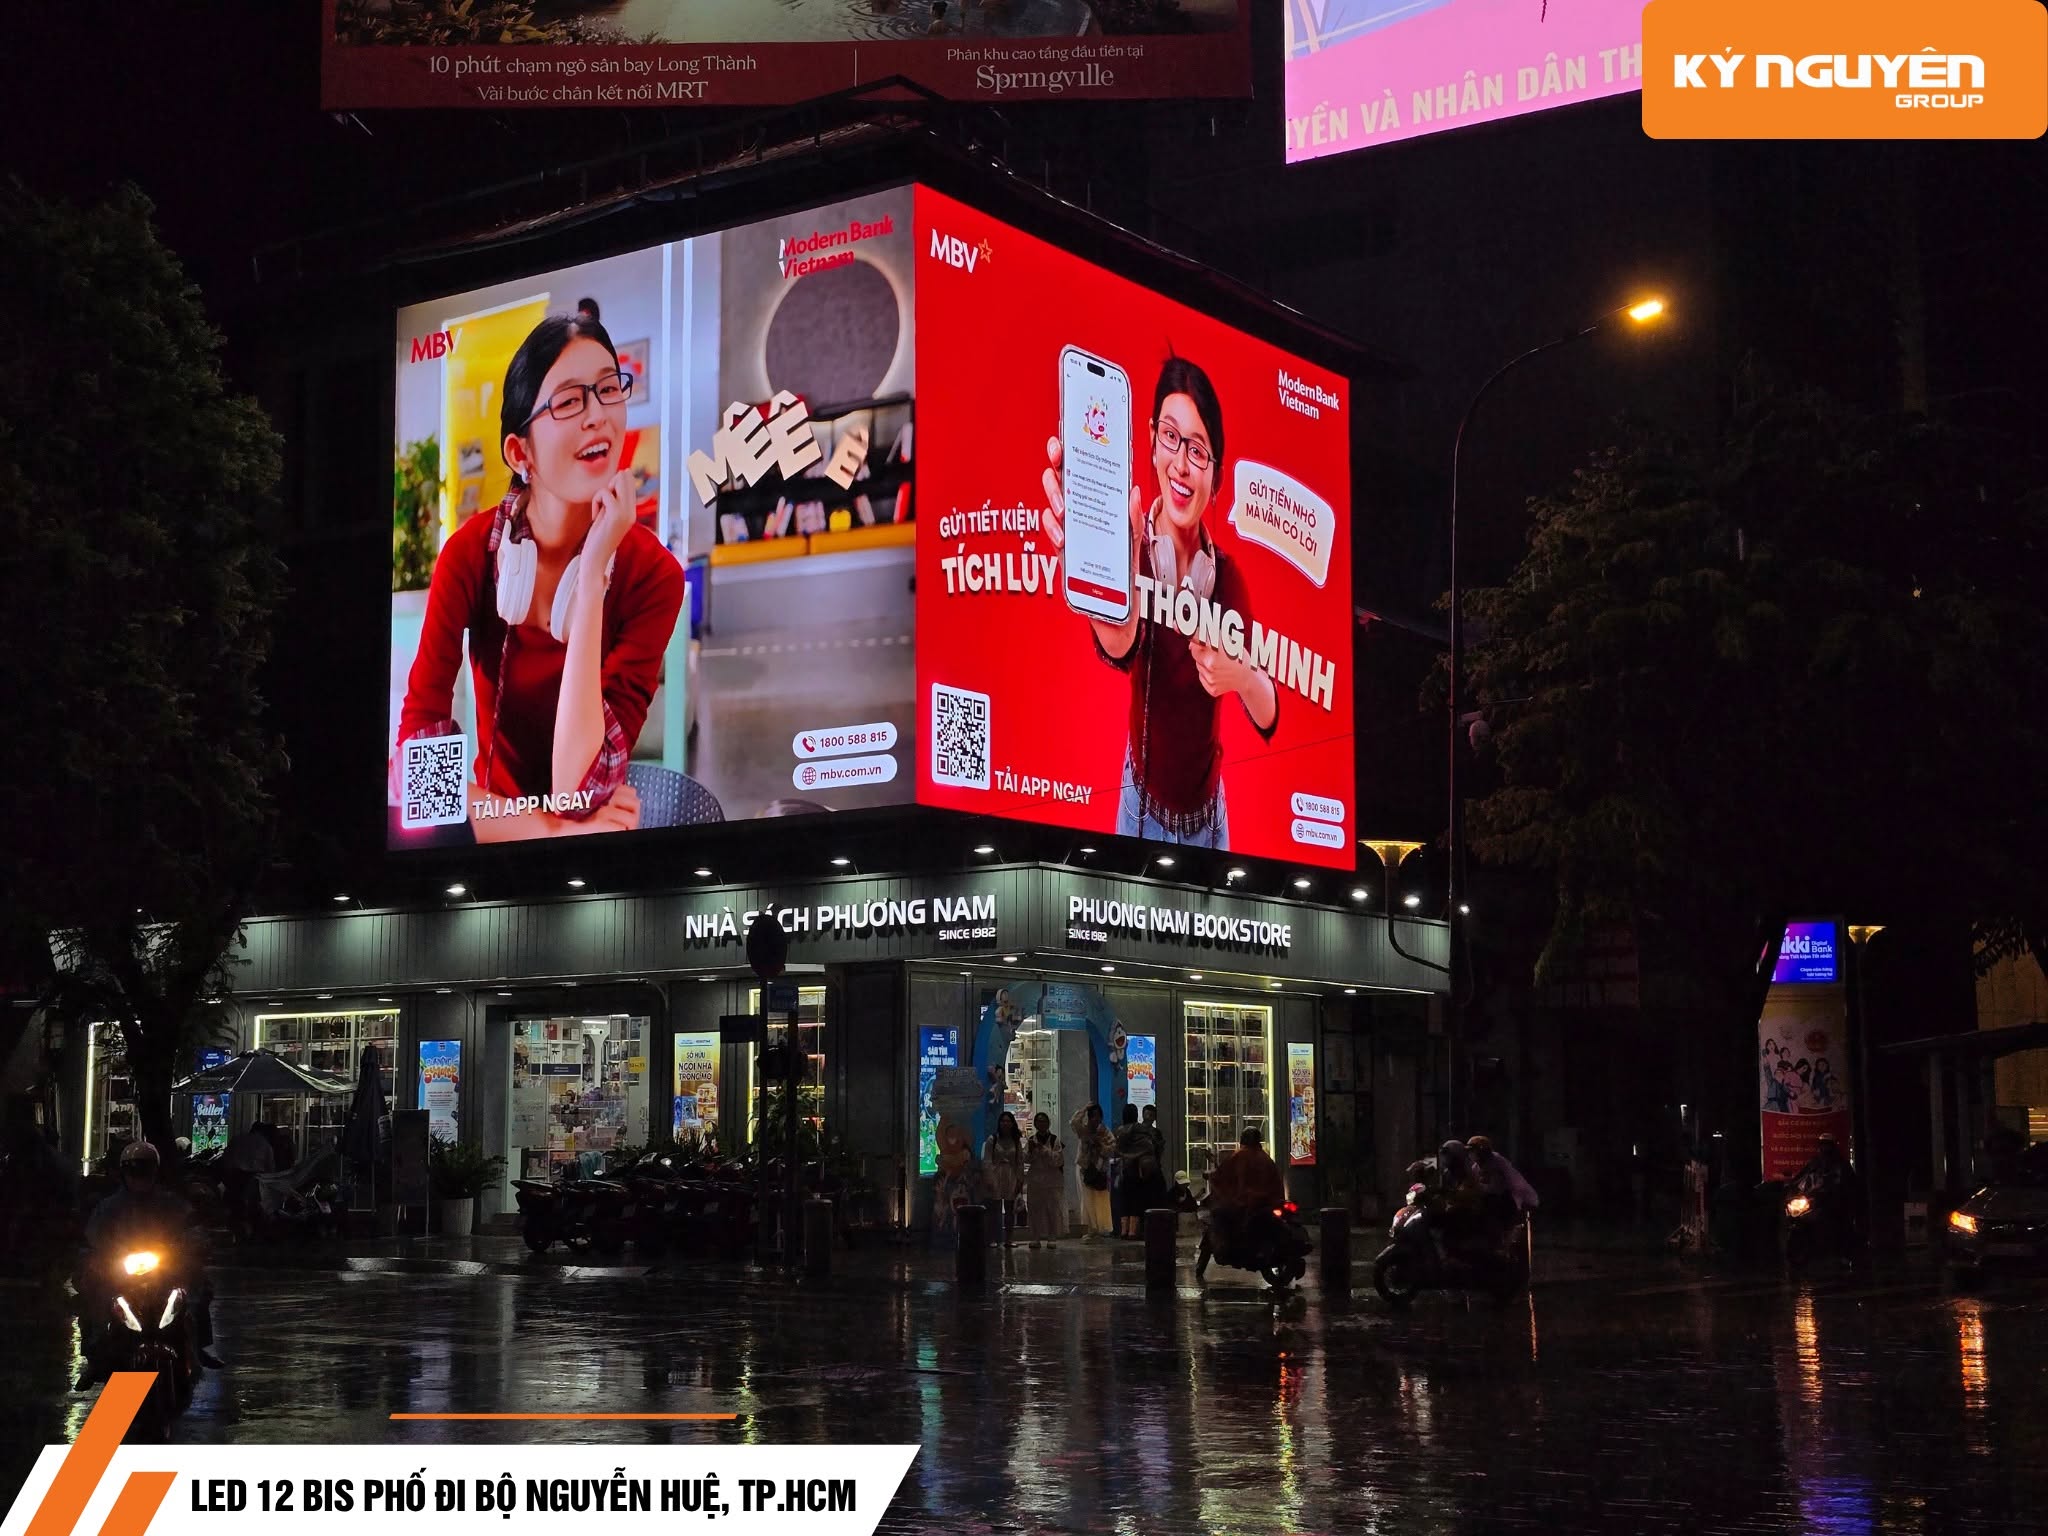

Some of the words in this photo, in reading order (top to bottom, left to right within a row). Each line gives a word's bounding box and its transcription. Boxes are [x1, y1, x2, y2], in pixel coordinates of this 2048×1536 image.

[429, 56, 449, 73] 10
[455, 55, 501, 78] phút
[506, 58, 551, 76] chạm
[556, 57, 586, 76] ngõ
[590, 57, 619, 72] sân
[624, 57, 654, 75] bay
[658, 57, 700, 74] Long
[703, 55, 757, 71] Thành
[947, 47, 980, 61] Phân
[984, 47, 1009, 60] khu
[1011, 49, 1036, 60] cao
[1099, 45, 1124, 57] tiên
[1127, 45, 1144, 60] tại
[477, 86, 503, 101] Vài
[507, 85, 549, 101] bước
[552, 85, 593, 100] chân
[597, 82, 623, 100] kết
[627, 82, 652, 99] nối
[656, 81, 708, 99] MRT
[976, 63, 1114, 95] Springville
[1286, 100, 1348, 149] YỀN
[1361, 89, 1400, 134] VÀ
[1413, 70, 1503, 125] NHÂN
[1518, 52, 1586, 102] DÂN
[779, 230, 848, 260] Modern
[850, 214, 894, 242] Bank
[930, 228, 979, 273] MBV
[778, 250, 855, 279] Vietnam
[411, 329, 463, 363] MBV
[1278, 369, 1316, 401] Modern
[1316, 385, 1339, 410] Bank
[1278, 387, 1320, 419] Vietnam
[940, 507, 967, 538] GỬI
[968, 499, 999, 533] TIẾT
[1001, 501, 1040, 538] KIỆM
[1249, 479, 1268, 500] GỬI
[1269, 486, 1292, 512] TIỀN
[1293, 503, 1317, 529] NHỎ
[1246, 502, 1262, 519] MÀ
[1262, 506, 1281, 529] VẪN
[1283, 519, 1298, 540] CÓ
[1300, 530, 1317, 556] LỜI
[941, 542, 1002, 594] TÍCH
[1006, 541, 1059, 595] LŨY
[1135, 574, 1244, 661] THÔNG
[1251, 620, 1336, 712] MINH
[820, 736, 844, 748] 1800
[848, 733, 867, 745] 588
[870, 731, 888, 742] 815
[820, 766, 882, 781] mbv.com.vn
[994, 765, 1018, 792] TẢI
[1020, 775, 1050, 797] APP
[1053, 780, 1092, 805] NGAY
[472, 793, 499, 820] TẢI
[502, 796, 540, 816] APP
[543, 789, 595, 813] NGAY
[1305, 828, 1338, 842] mbv.com.vn
[686, 906, 737, 939] NHÀ
[743, 902, 809, 936] SCH
[817, 897, 926, 931] PHƯƠNG
[933, 894, 996, 923] NAM
[1069, 895, 1146, 930] PHUONG
[1150, 907, 1190, 936] NAM
[1193, 912, 1292, 948] BOOKSTORE
[939, 928, 970, 941] SINCE
[971, 927, 996, 939] 1982
[1068, 928, 1090, 940] SINCE
[1811, 945, 1833, 953] Bank
